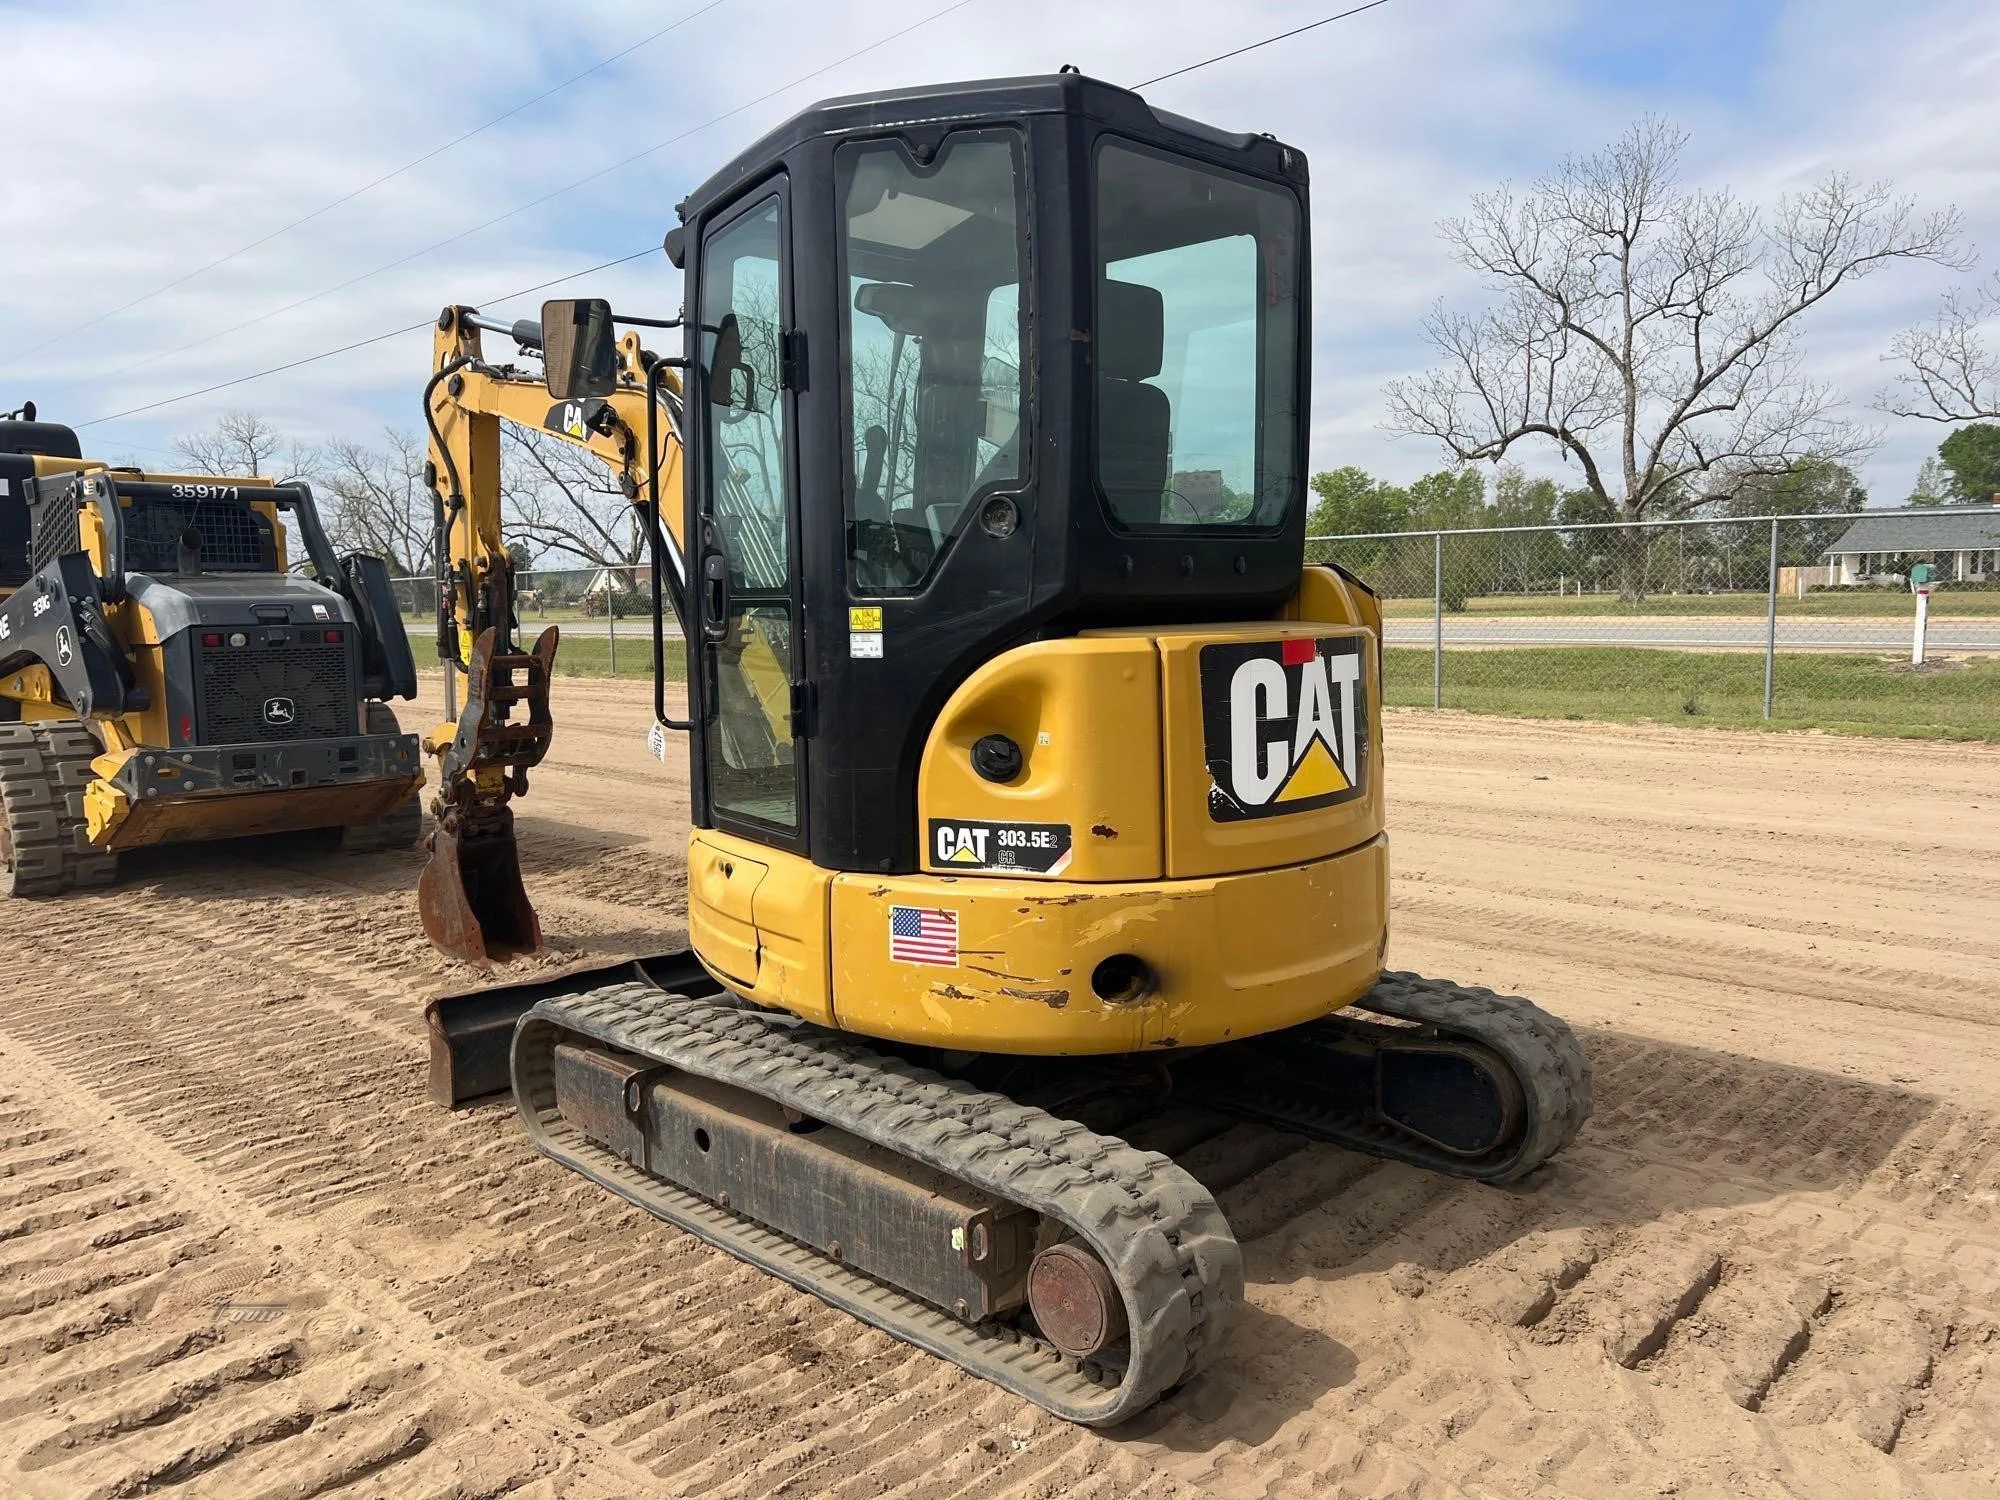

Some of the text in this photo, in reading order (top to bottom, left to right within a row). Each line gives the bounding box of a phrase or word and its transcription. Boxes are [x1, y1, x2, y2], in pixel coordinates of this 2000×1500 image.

[171, 484, 239, 500] 359171
[1230, 652, 1360, 806] CAT
[937, 826, 989, 863] CAT
[997, 850, 1015, 865] CR
